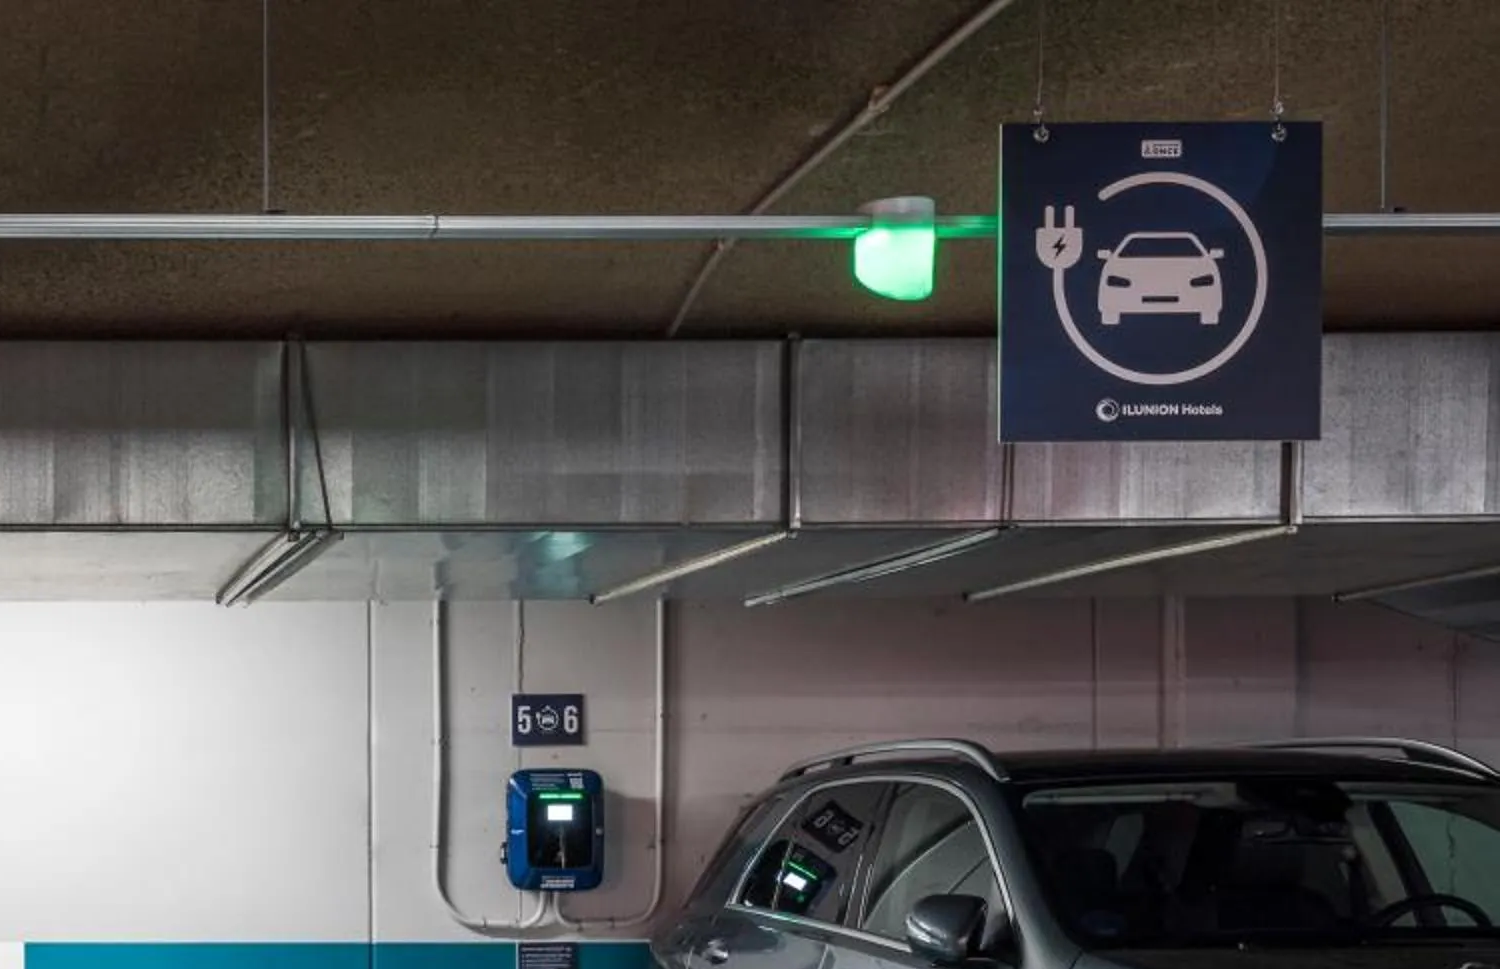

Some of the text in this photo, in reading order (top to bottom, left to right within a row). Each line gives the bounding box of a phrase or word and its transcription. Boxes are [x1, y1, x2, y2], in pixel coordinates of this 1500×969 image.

[1122, 403, 1224, 416] ILUNION Hotels
[517, 705, 579, 734] 5 6
